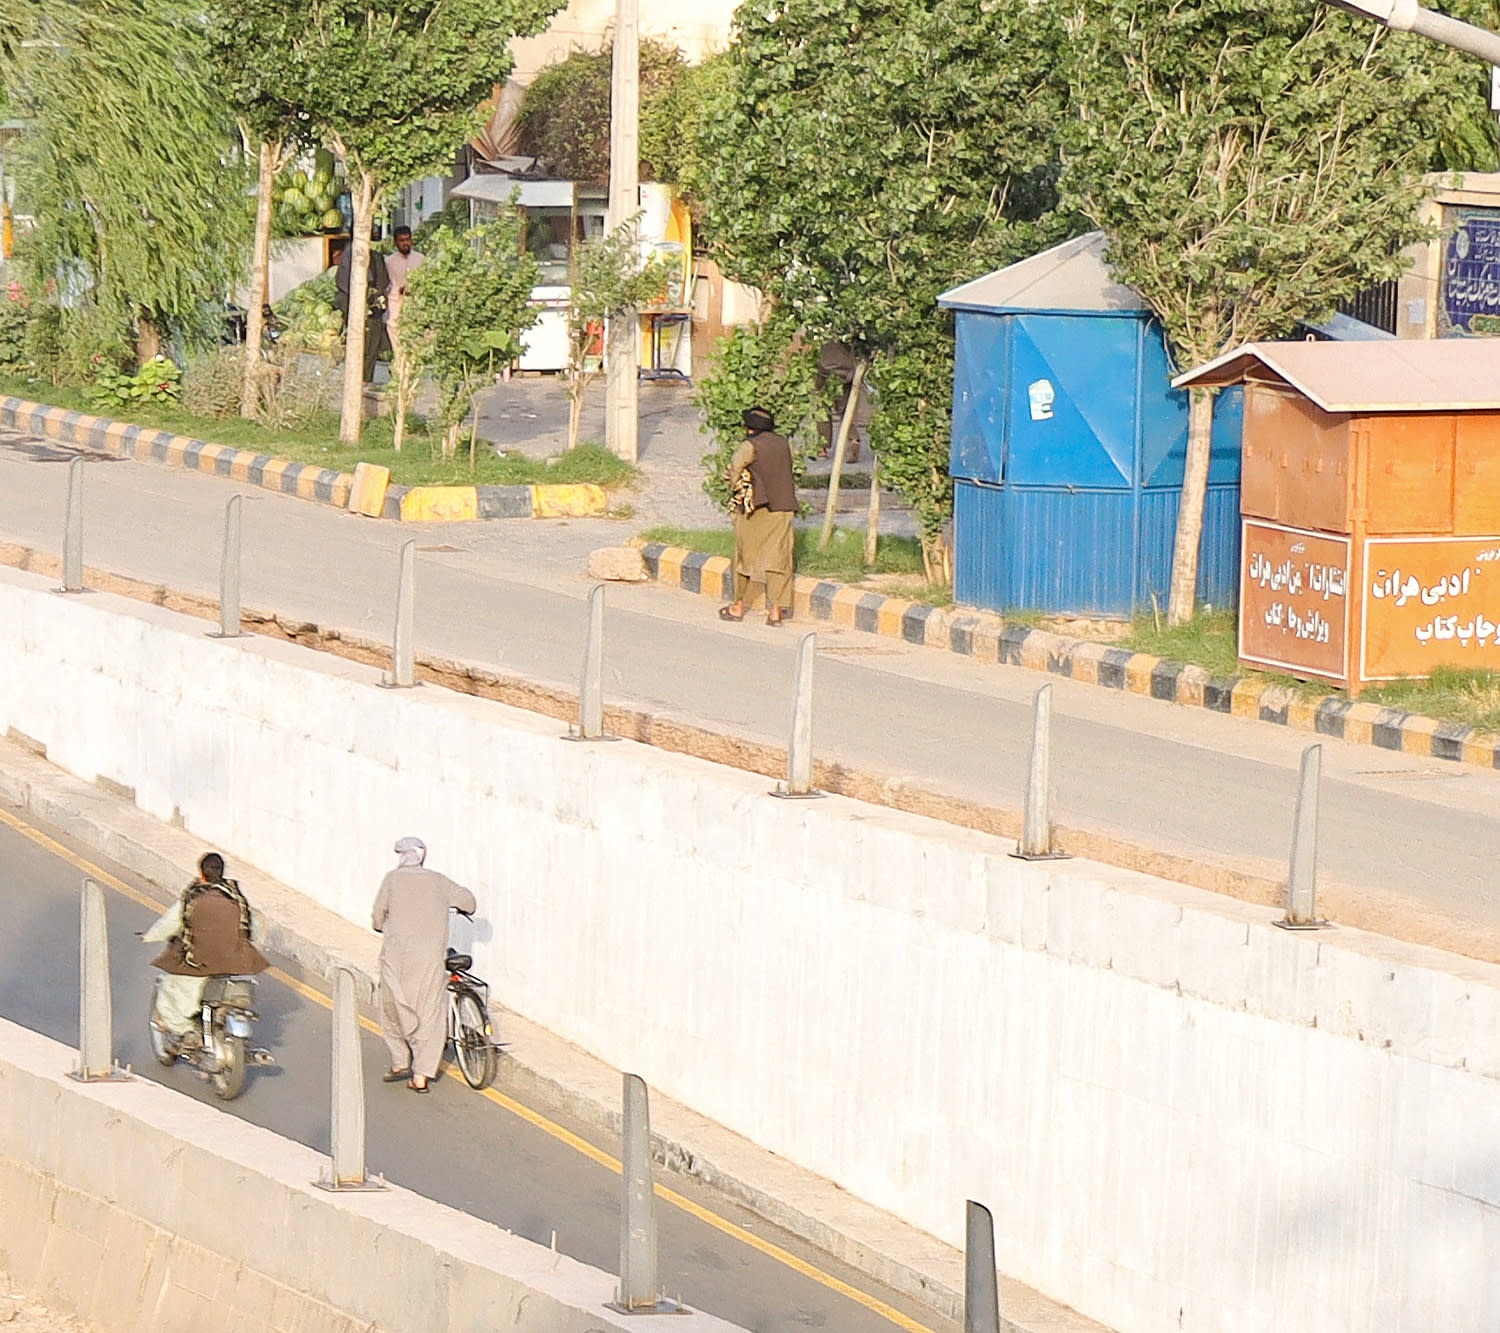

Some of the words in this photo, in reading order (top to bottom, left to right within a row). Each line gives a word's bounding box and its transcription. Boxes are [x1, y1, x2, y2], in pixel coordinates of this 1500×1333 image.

[1371, 569, 1421, 606] هرات
[1421, 567, 1471, 606] ادبی
[1415, 615, 1458, 646] کتاب
[1456, 613, 1496, 647] چاپ
